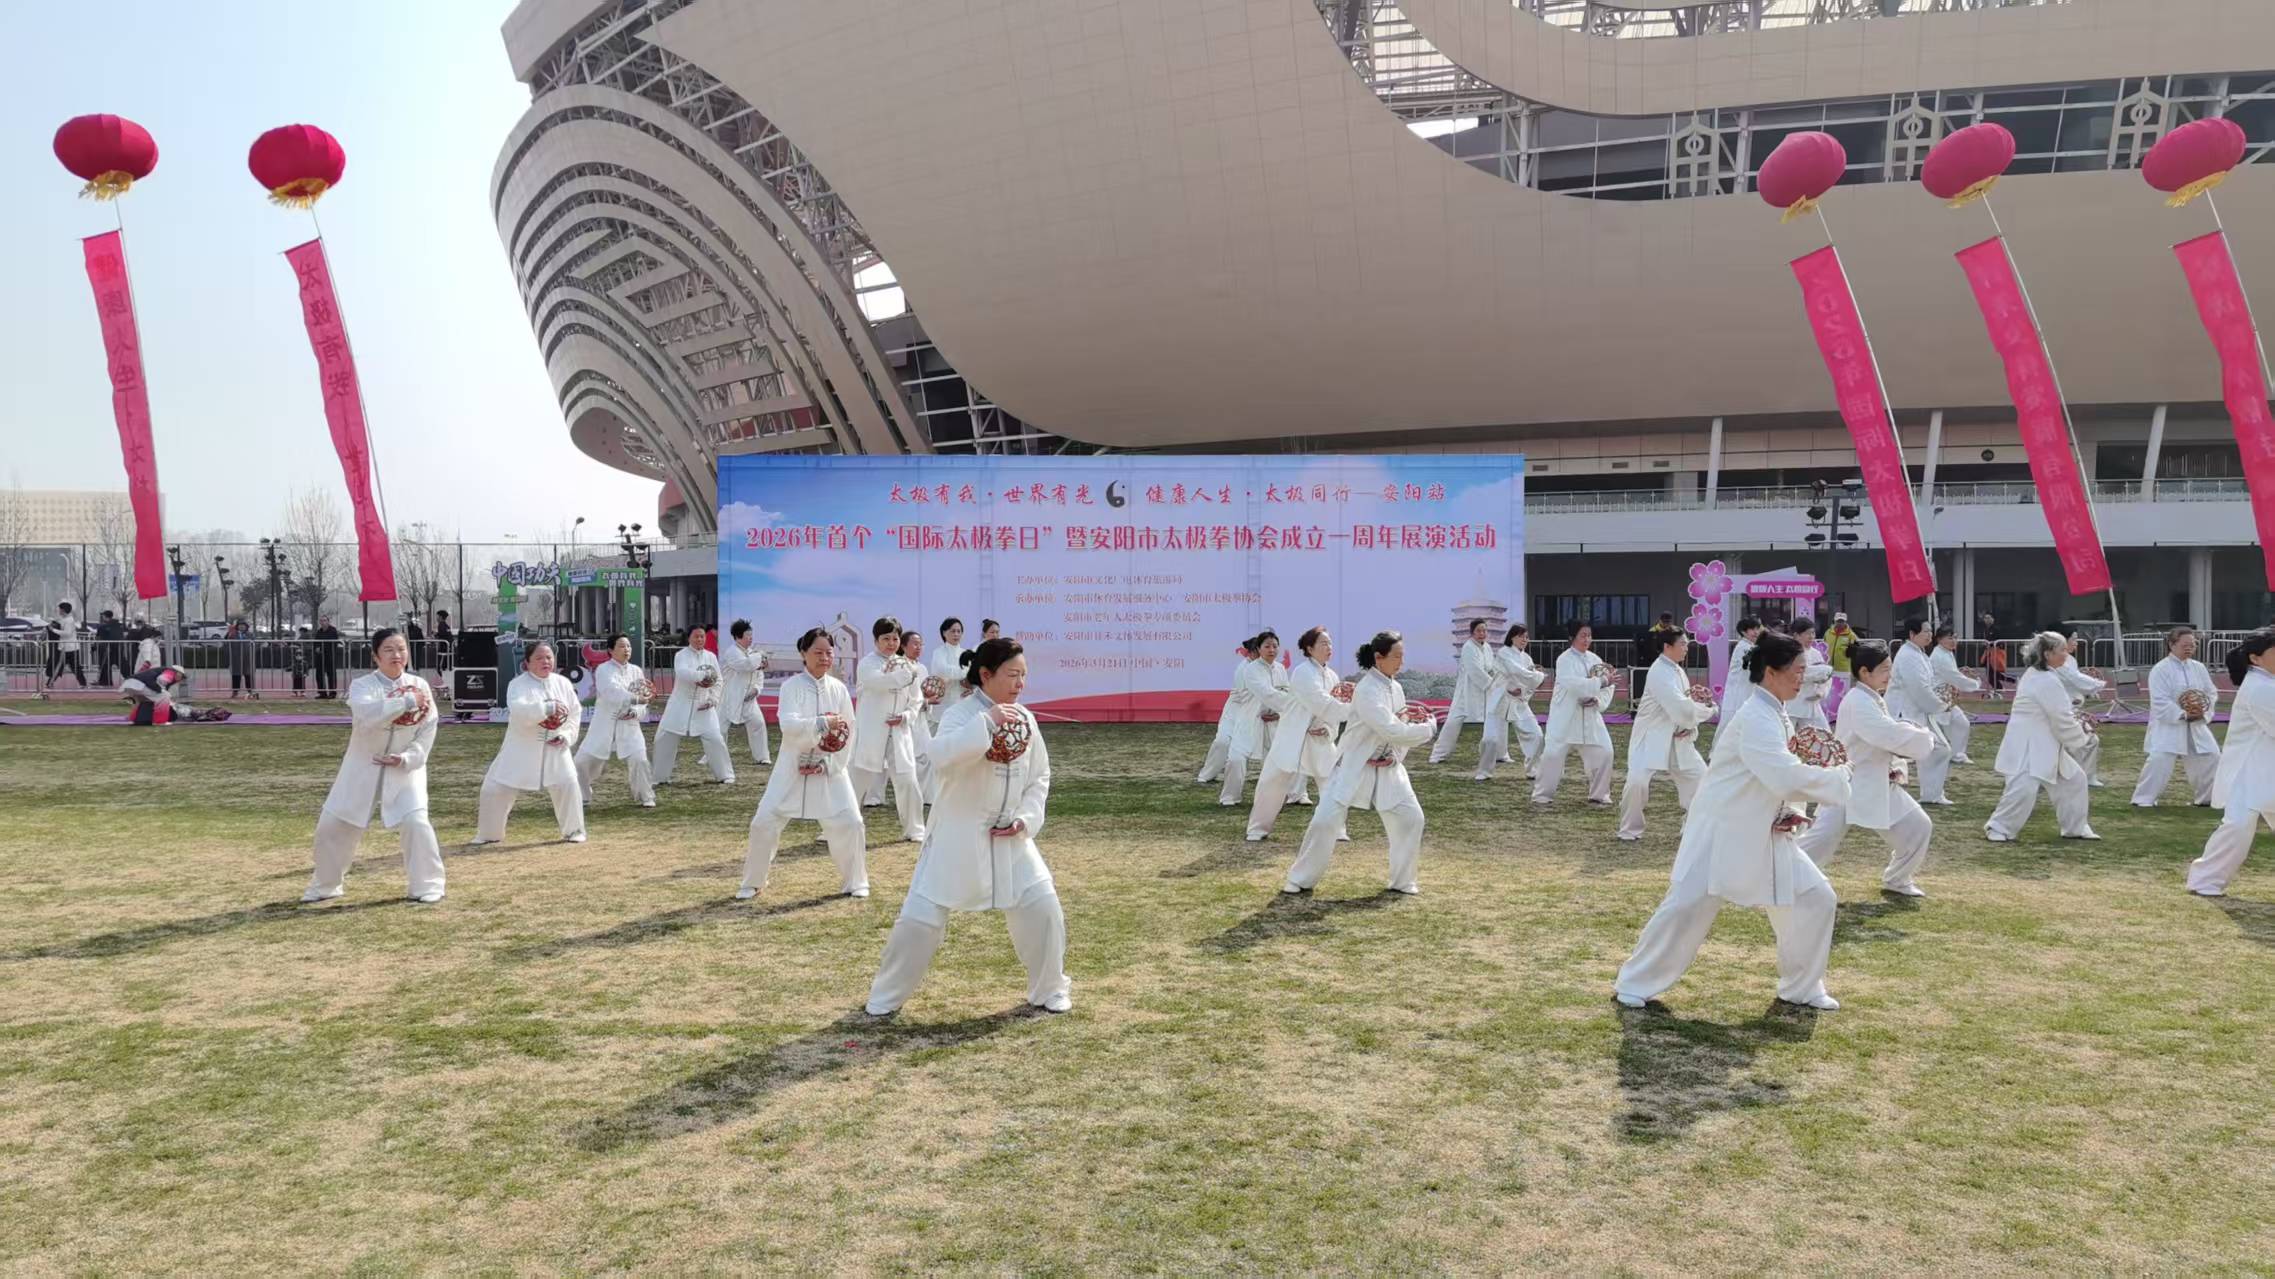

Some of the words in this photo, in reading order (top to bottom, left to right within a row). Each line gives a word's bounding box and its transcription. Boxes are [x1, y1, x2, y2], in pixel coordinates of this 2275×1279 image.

[888, 483, 1094, 505] 太极有我·世界有光
[492, 561, 561, 588] 中国功夫
